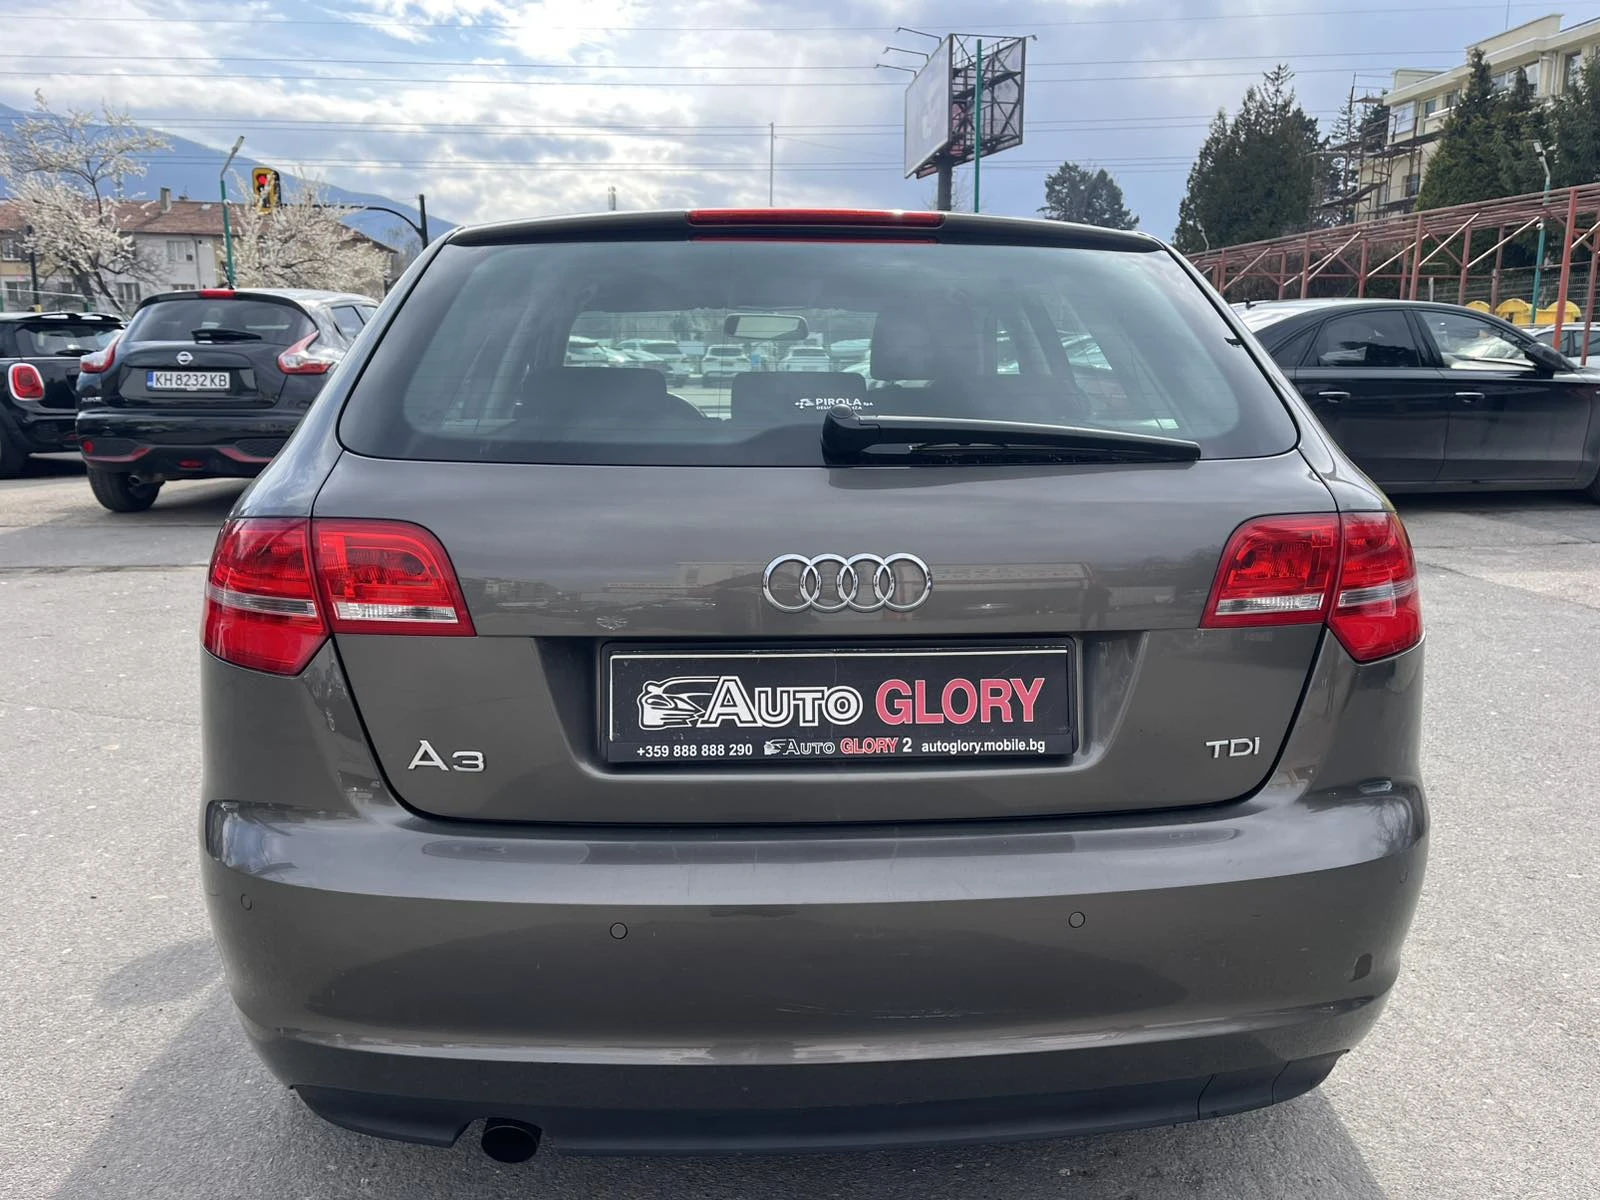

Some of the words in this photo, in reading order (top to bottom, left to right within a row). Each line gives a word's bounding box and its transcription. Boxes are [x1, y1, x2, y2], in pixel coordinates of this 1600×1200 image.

[155, 373, 227, 387] KH8232KB
[815, 398, 862, 406] PIROLA
[875, 678, 1045, 725] GLORY
[407, 739, 485, 772] A3
[637, 745, 669, 758] +359
[673, 745, 697, 757] 888
[701, 744, 725, 757] 888
[729, 743, 753, 756] 290
[840, 737, 899, 755] GLORY
[902, 737, 913, 753] 2
[921, 738, 1046, 755] autoglory.mobile.bg
[1205, 736, 1261, 759] TDI
